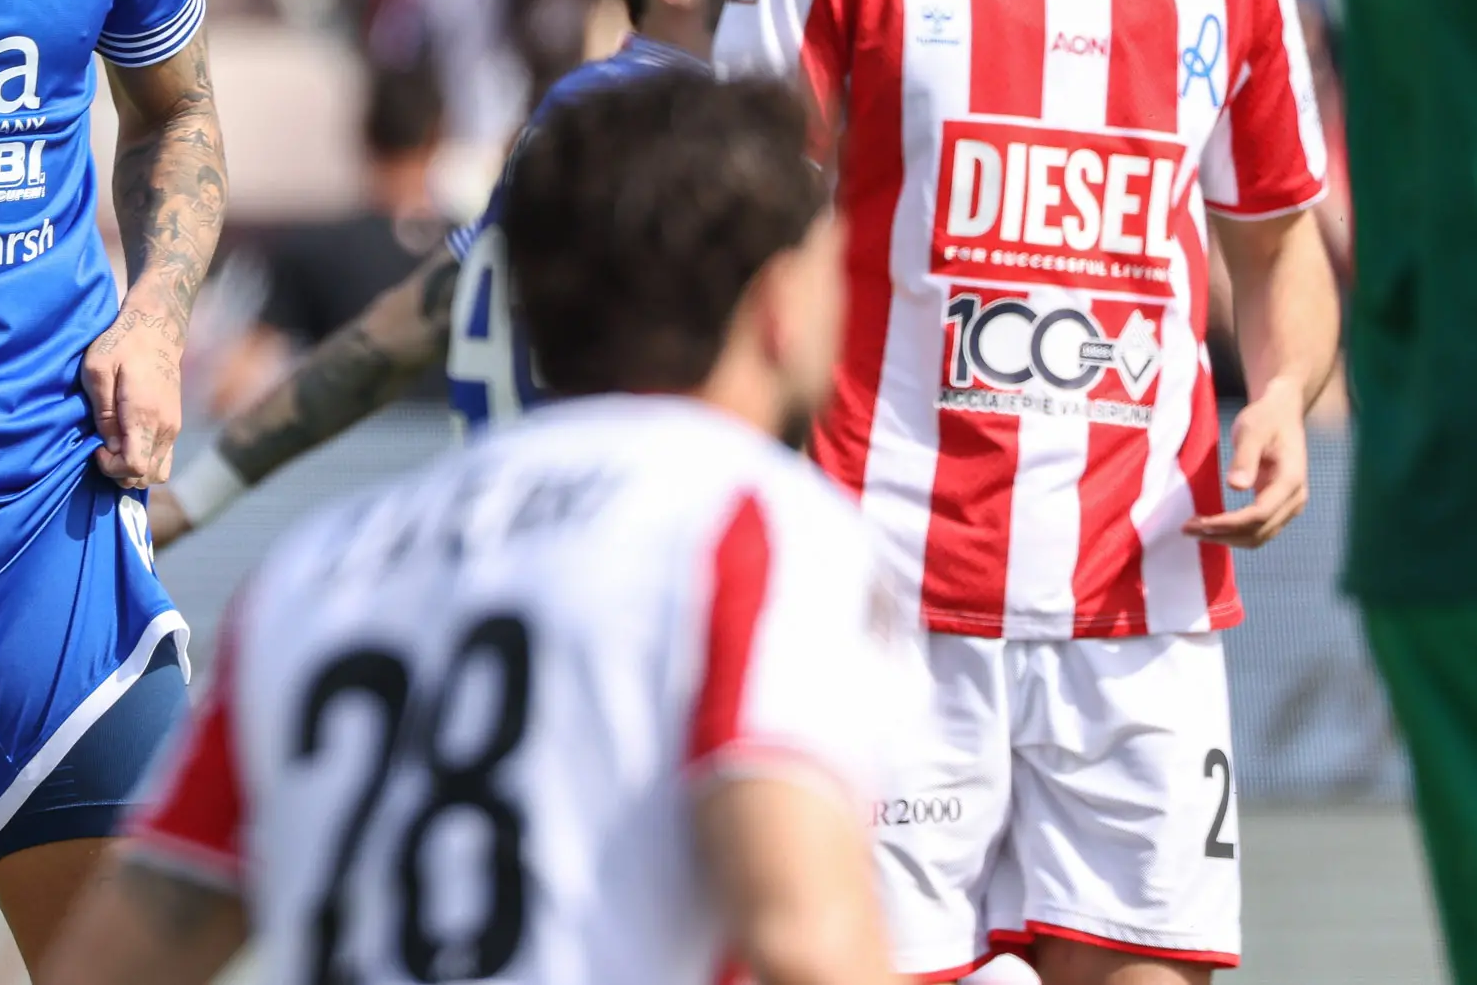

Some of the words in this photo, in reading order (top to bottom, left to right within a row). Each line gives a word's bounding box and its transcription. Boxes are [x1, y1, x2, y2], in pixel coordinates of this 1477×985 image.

[946, 139, 1176, 259] DIESEL
[944, 246, 987, 263] FOR
[990, 250, 1108, 278] SUCCESSFUL
[1110, 262, 1174, 282] LIVIN
[867, 795, 964, 828] R2000
